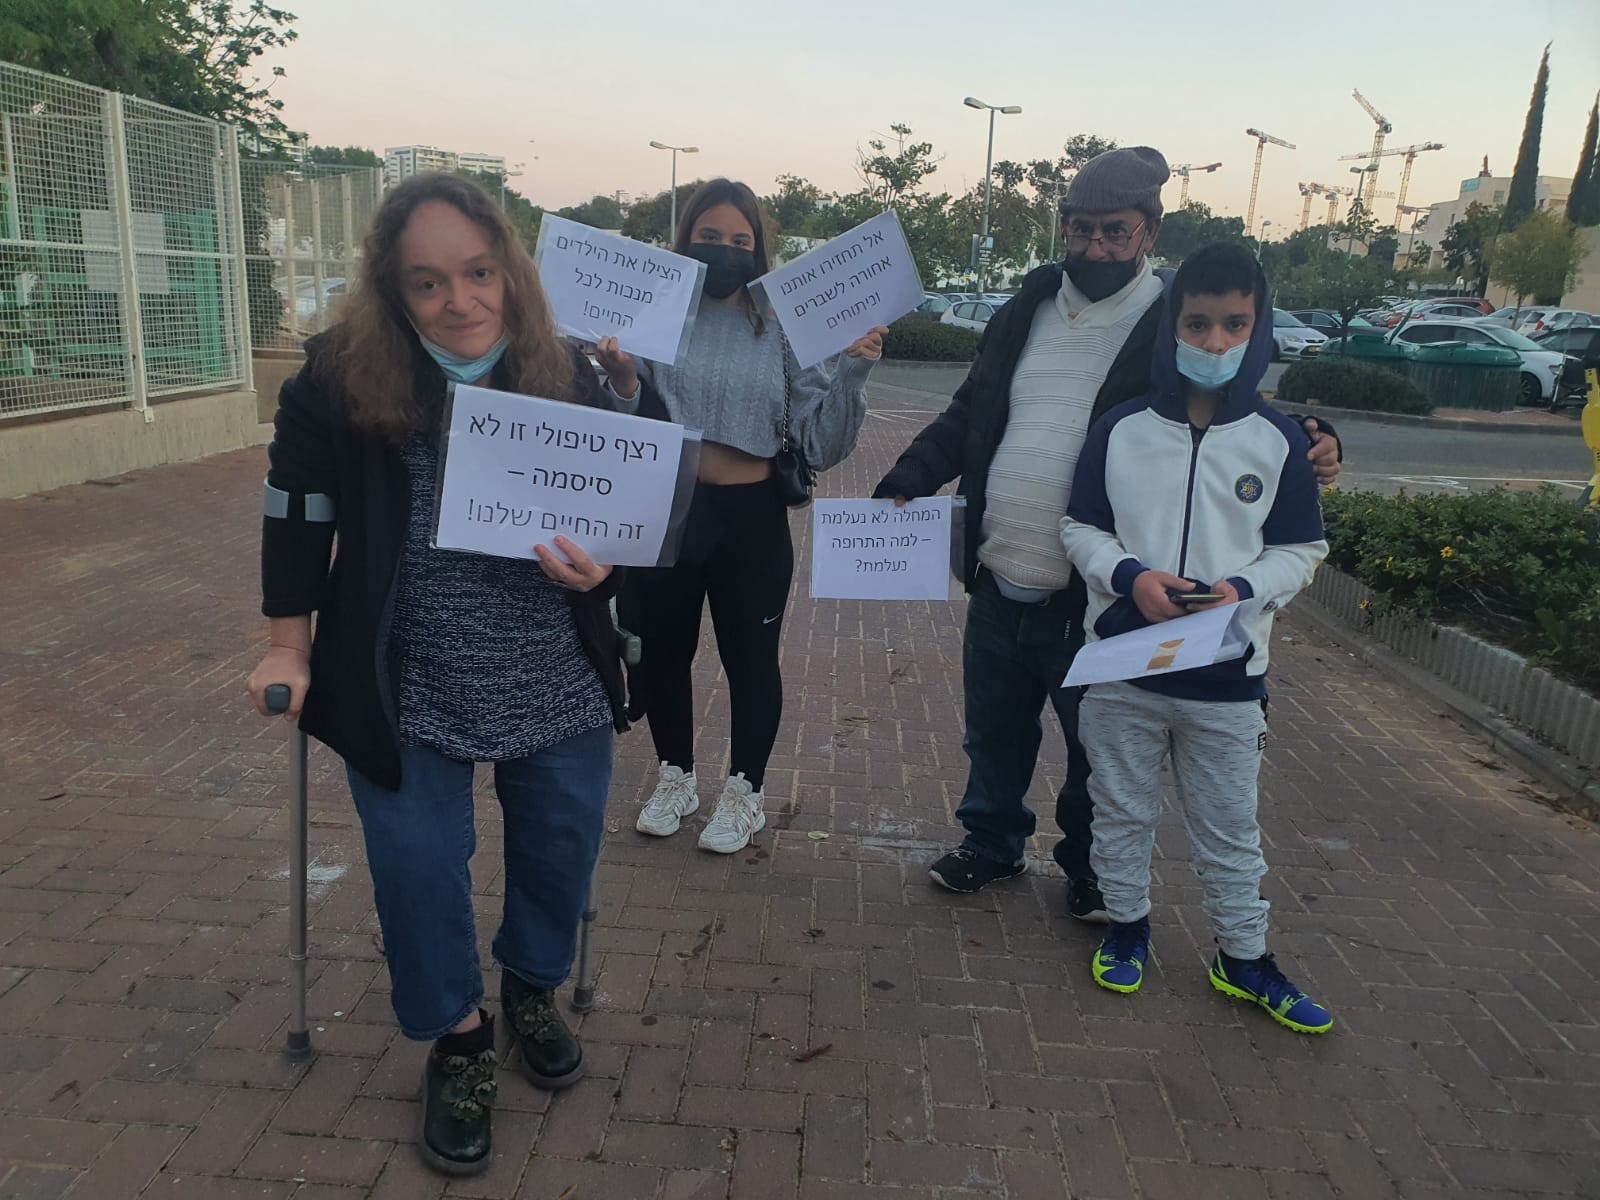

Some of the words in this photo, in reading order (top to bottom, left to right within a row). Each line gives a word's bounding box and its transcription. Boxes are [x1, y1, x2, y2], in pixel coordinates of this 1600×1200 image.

[556, 235, 609, 264] הילדים
[863, 230, 885, 249] אל
[612, 250, 638, 271] את
[641, 257, 682, 283] הצילו
[819, 242, 864, 275] תחזירו
[575, 266, 603, 289] לכל
[780, 267, 818, 296] אותנו
[848, 255, 892, 288] אחורה
[606, 279, 653, 305] מנכות
[794, 281, 845, 318] לשברים
[583, 300, 634, 329] החיים!
[826, 291, 881, 329] וניתוחים
[468, 412, 500, 437] לא
[510, 421, 527, 441] זו
[535, 421, 606, 453] טיפולי
[614, 438, 659, 462] רצף
[532, 467, 613, 496] סיסמה
[467, 498, 533, 527] שלנו!
[821, 510, 867, 525] נעלמת
[871, 510, 889, 524] לא
[893, 508, 941, 524] המחלה
[541, 512, 609, 539] החיים
[617, 522, 645, 540] זה
[832, 537, 885, 549] התרופה
[890, 532, 918, 548] למה
[855, 558, 908, 573] נעלמת?
